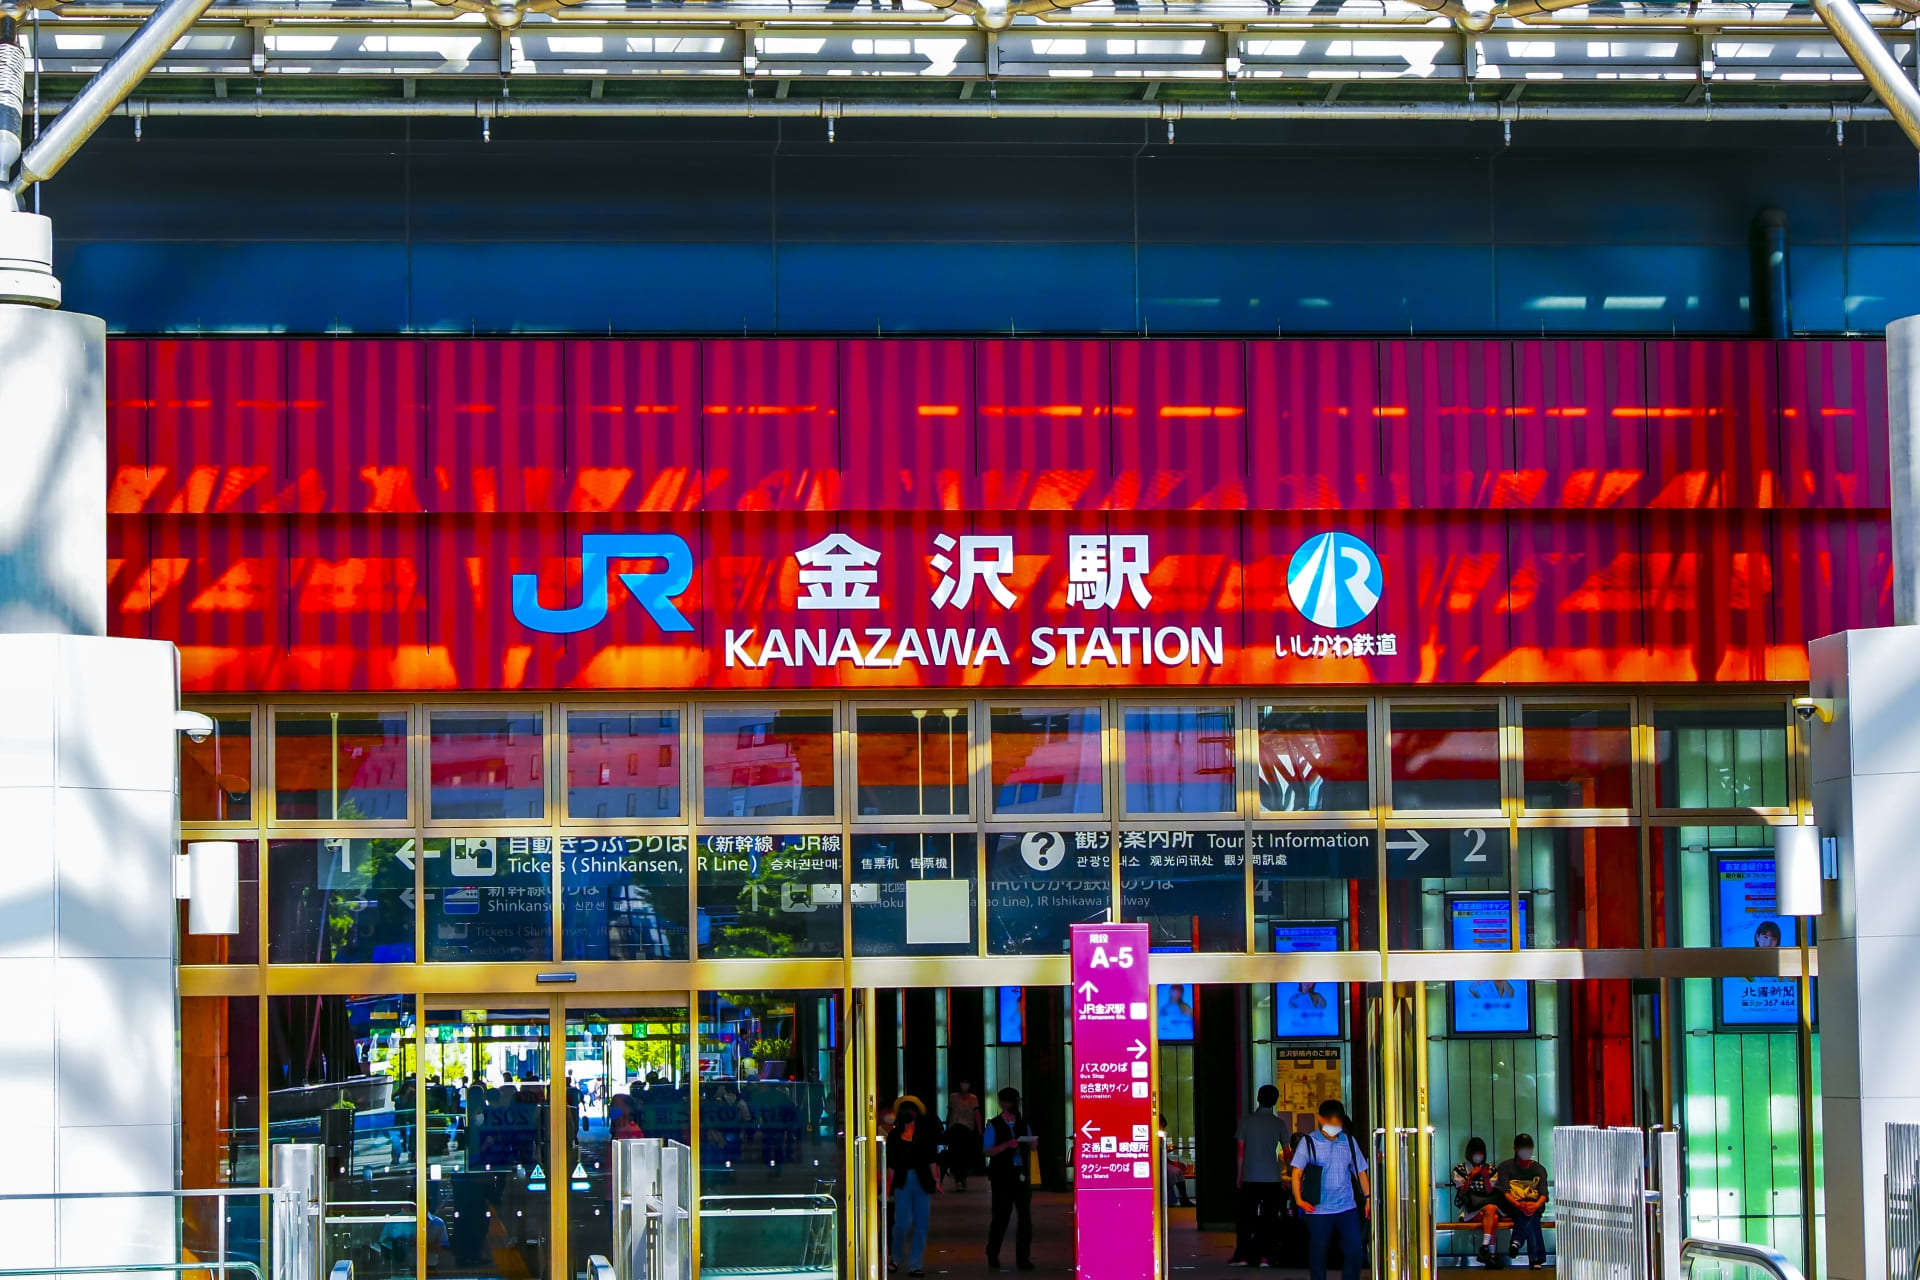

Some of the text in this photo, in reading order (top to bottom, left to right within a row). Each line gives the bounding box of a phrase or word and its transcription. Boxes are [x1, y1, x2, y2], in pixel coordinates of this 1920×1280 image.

[795, 533, 1153, 610] 金沢駅
[512, 533, 695, 633] JR
[725, 626, 1223, 667] KANAZAWA STATION
[1275, 633, 1398, 657] いしかわ鉄道
[1206, 831, 1369, 849] Tourst Information
[1463, 828, 1487, 861] 2
[508, 857, 566, 873] Tickes
[770, 858, 842, 871] 승차권판매
[1090, 946, 1134, 968] A-5
[1078, 1003, 1126, 1014] JR金沢駅
[1080, 1062, 1128, 1073] バスのりば
[1081, 1163, 1130, 1173] タクシーのりば
